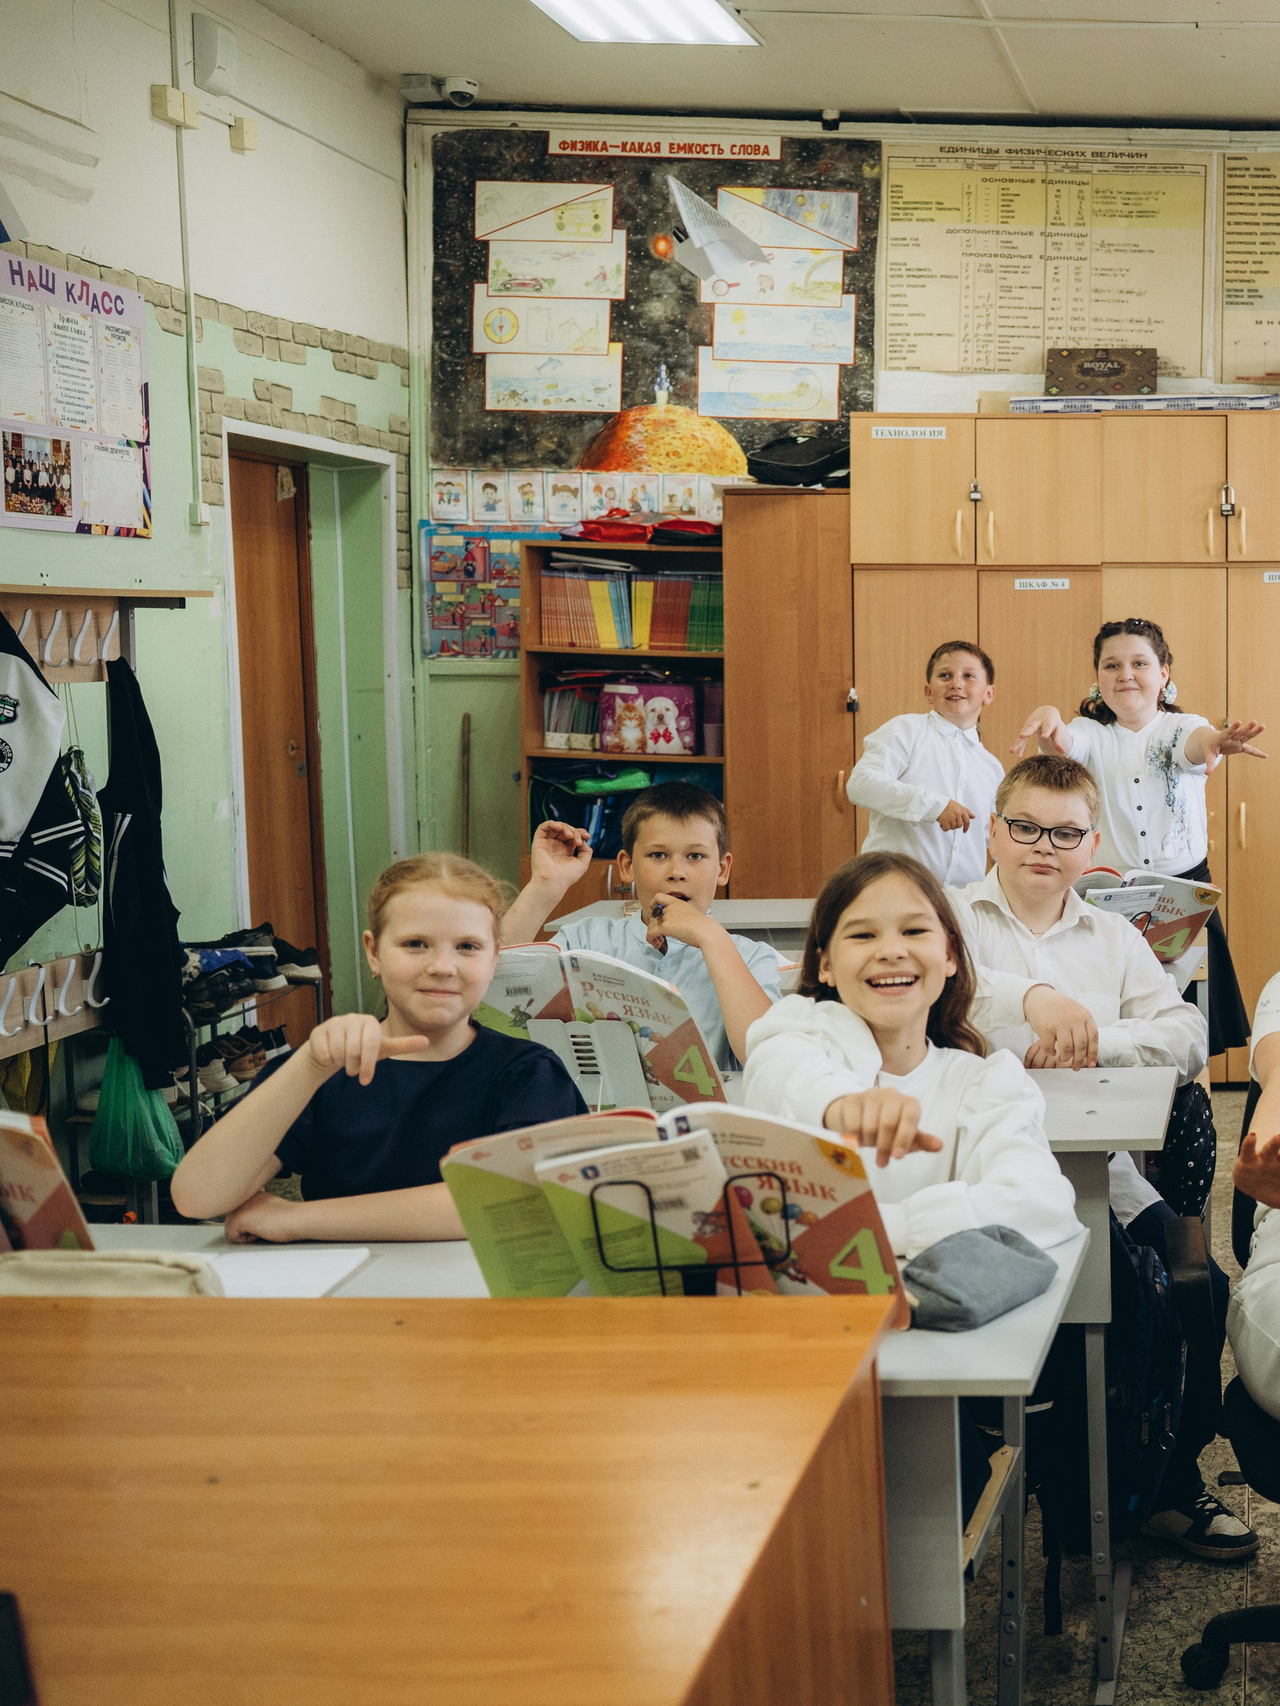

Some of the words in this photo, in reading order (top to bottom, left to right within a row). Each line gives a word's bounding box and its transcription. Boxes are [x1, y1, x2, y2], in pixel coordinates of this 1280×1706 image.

[669, 143, 724, 155] ЕМКОСТЬ
[731, 144, 770, 156] СЛОВА
[939, 146, 1000, 155] ЕДИНИЦЫ
[1005, 148, 1086, 158] ФИЗИЧЕСКИХ
[1091, 151, 1148, 159] ВЕЛИЧИН
[962, 252, 1033, 260] ПРОИЗВОДНЫЕ
[8, 260, 55, 295] НАШ
[66, 280, 124, 316] КЛАСС
[0, 297, 14, 306] ИСОК
[104, 324, 131, 336] РАСПИСАНИЕ
[874, 428, 944, 438] ТЕХНОЛОГИЯ
[1019, 580, 1049, 589] ШКАФ
[1154, 903, 1186, 916] зык
[1152, 928, 1192, 958] 4
[673, 1044, 718, 1096] 4
[723, 1156, 804, 1176] сский
[828, 1227, 896, 1297] 4
